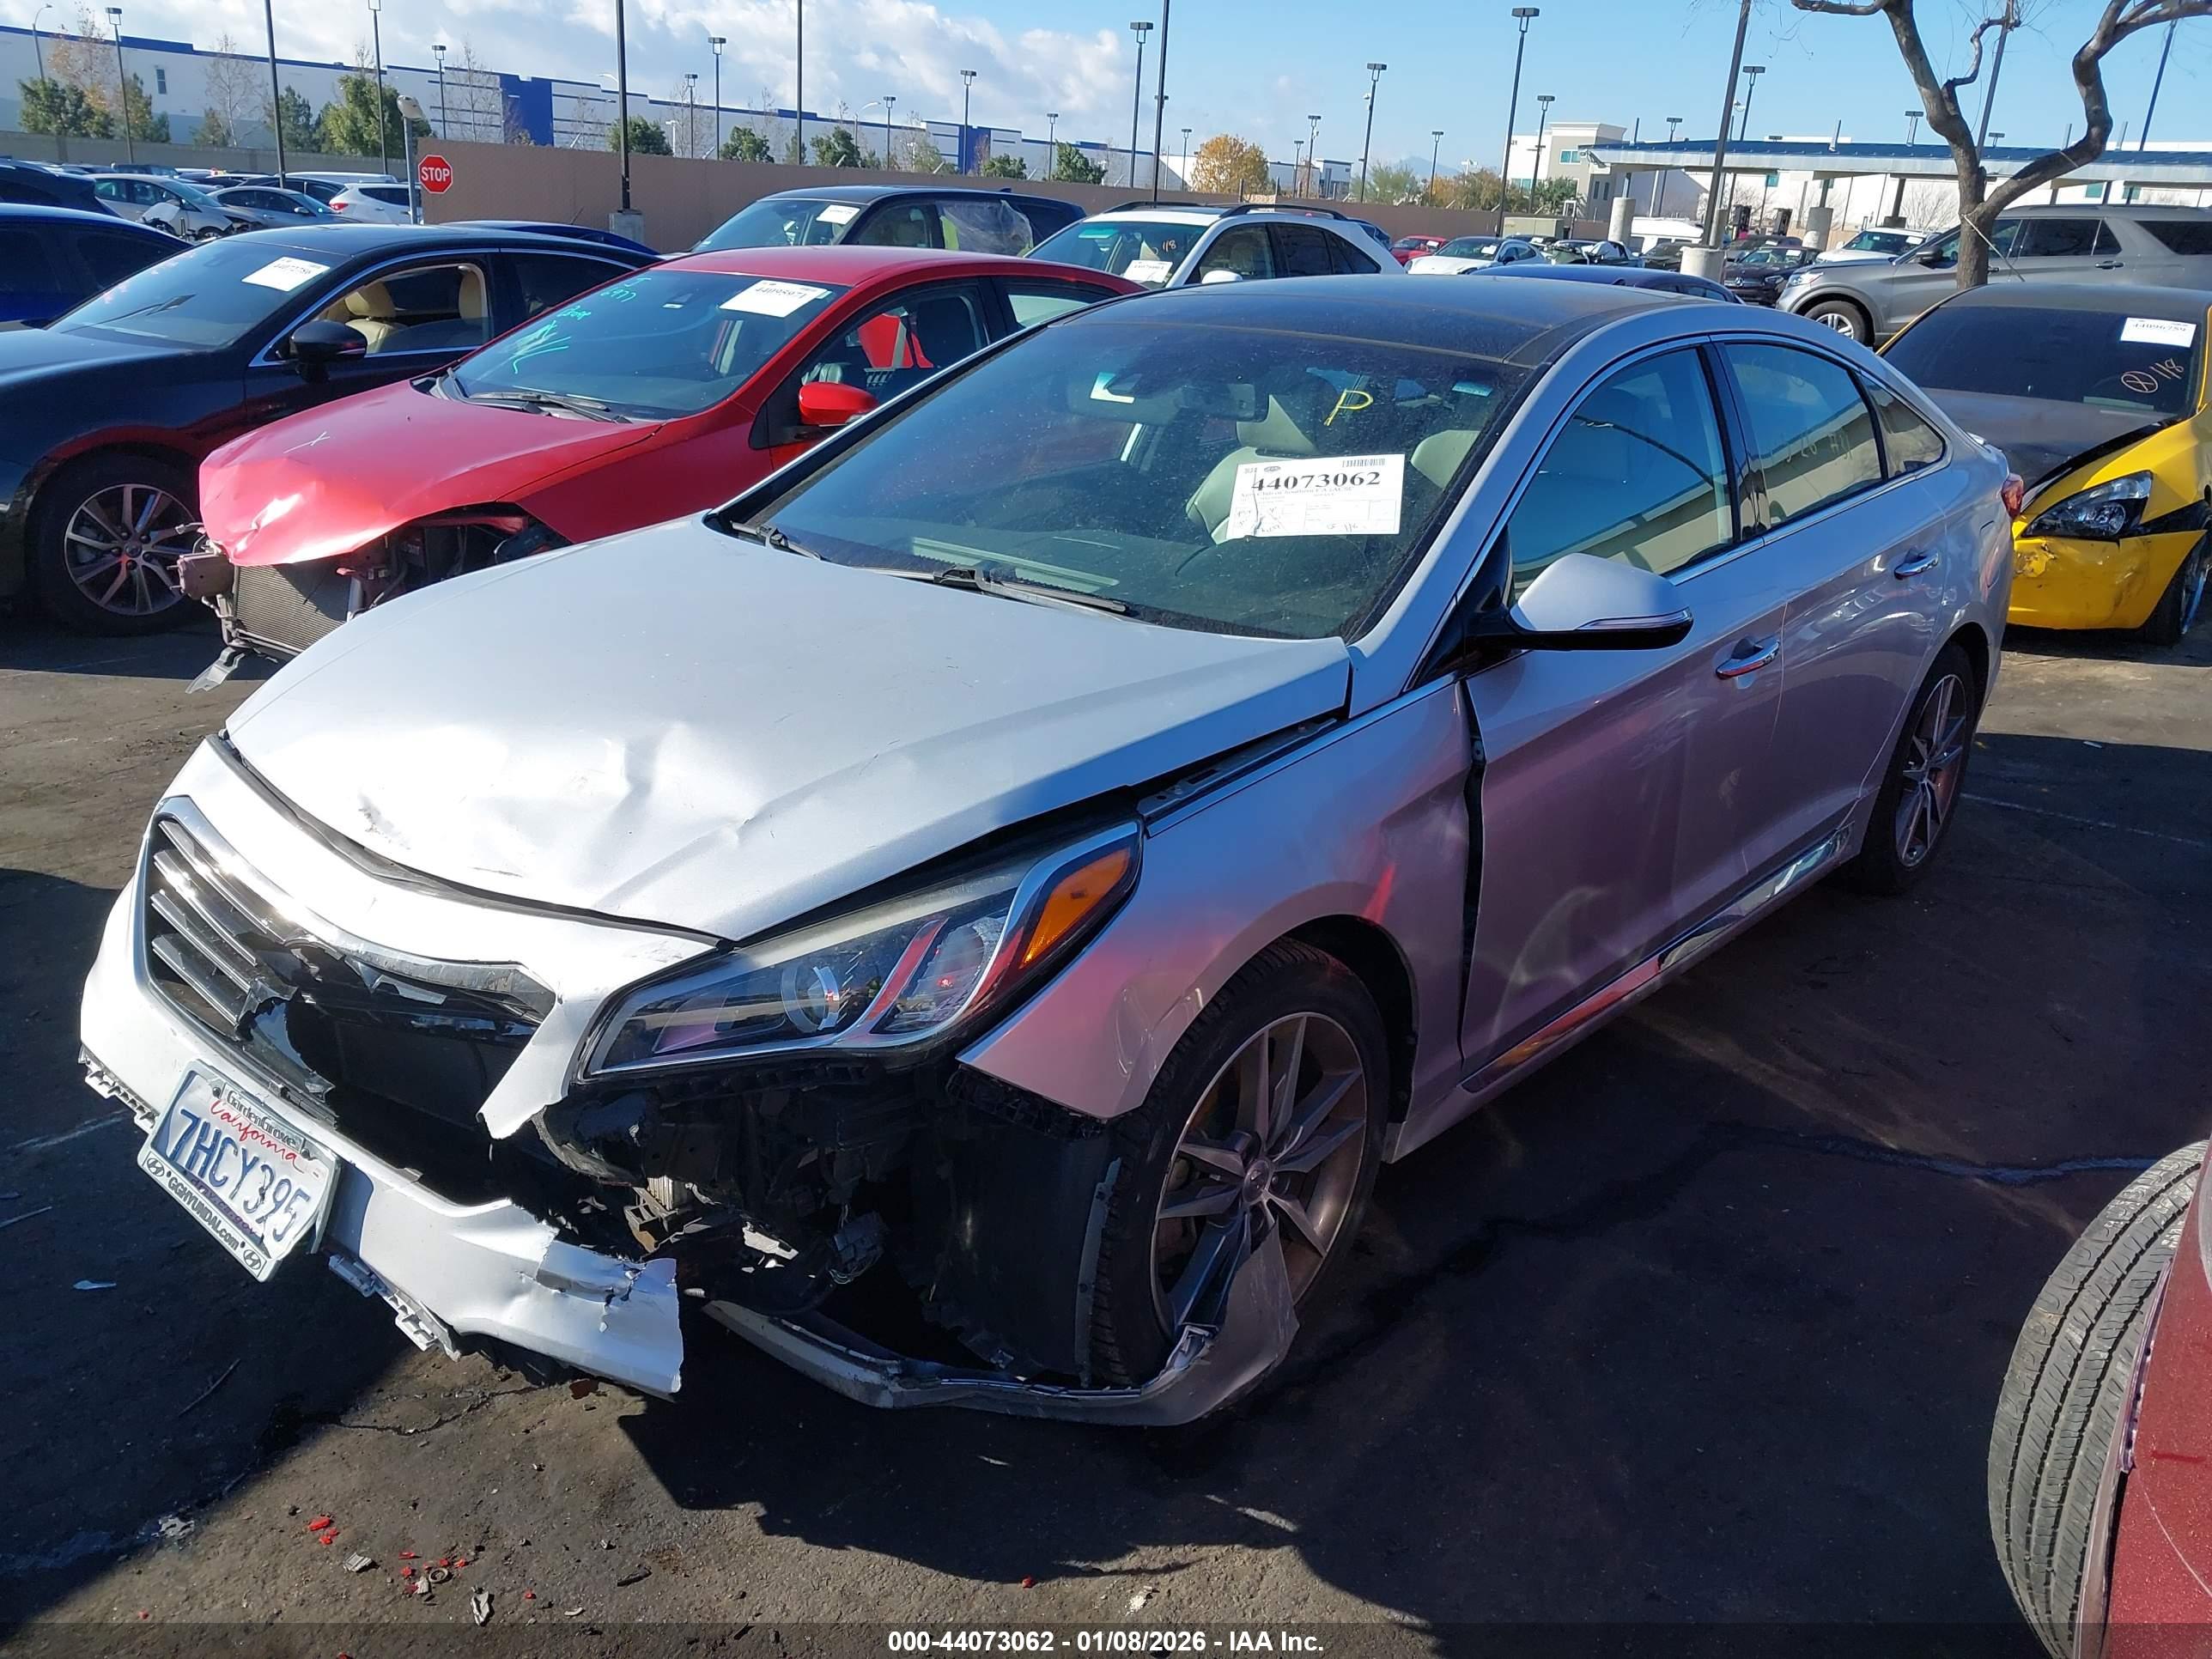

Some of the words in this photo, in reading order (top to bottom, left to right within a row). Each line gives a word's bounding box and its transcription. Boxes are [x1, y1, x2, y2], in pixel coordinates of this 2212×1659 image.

[421, 167, 450, 182] STOP
[1323, 388, 1374, 427] P
[1251, 471, 1381, 491] 44073062
[210, 1100, 304, 1174] California
[167, 1108, 311, 1243] 7HCY395
